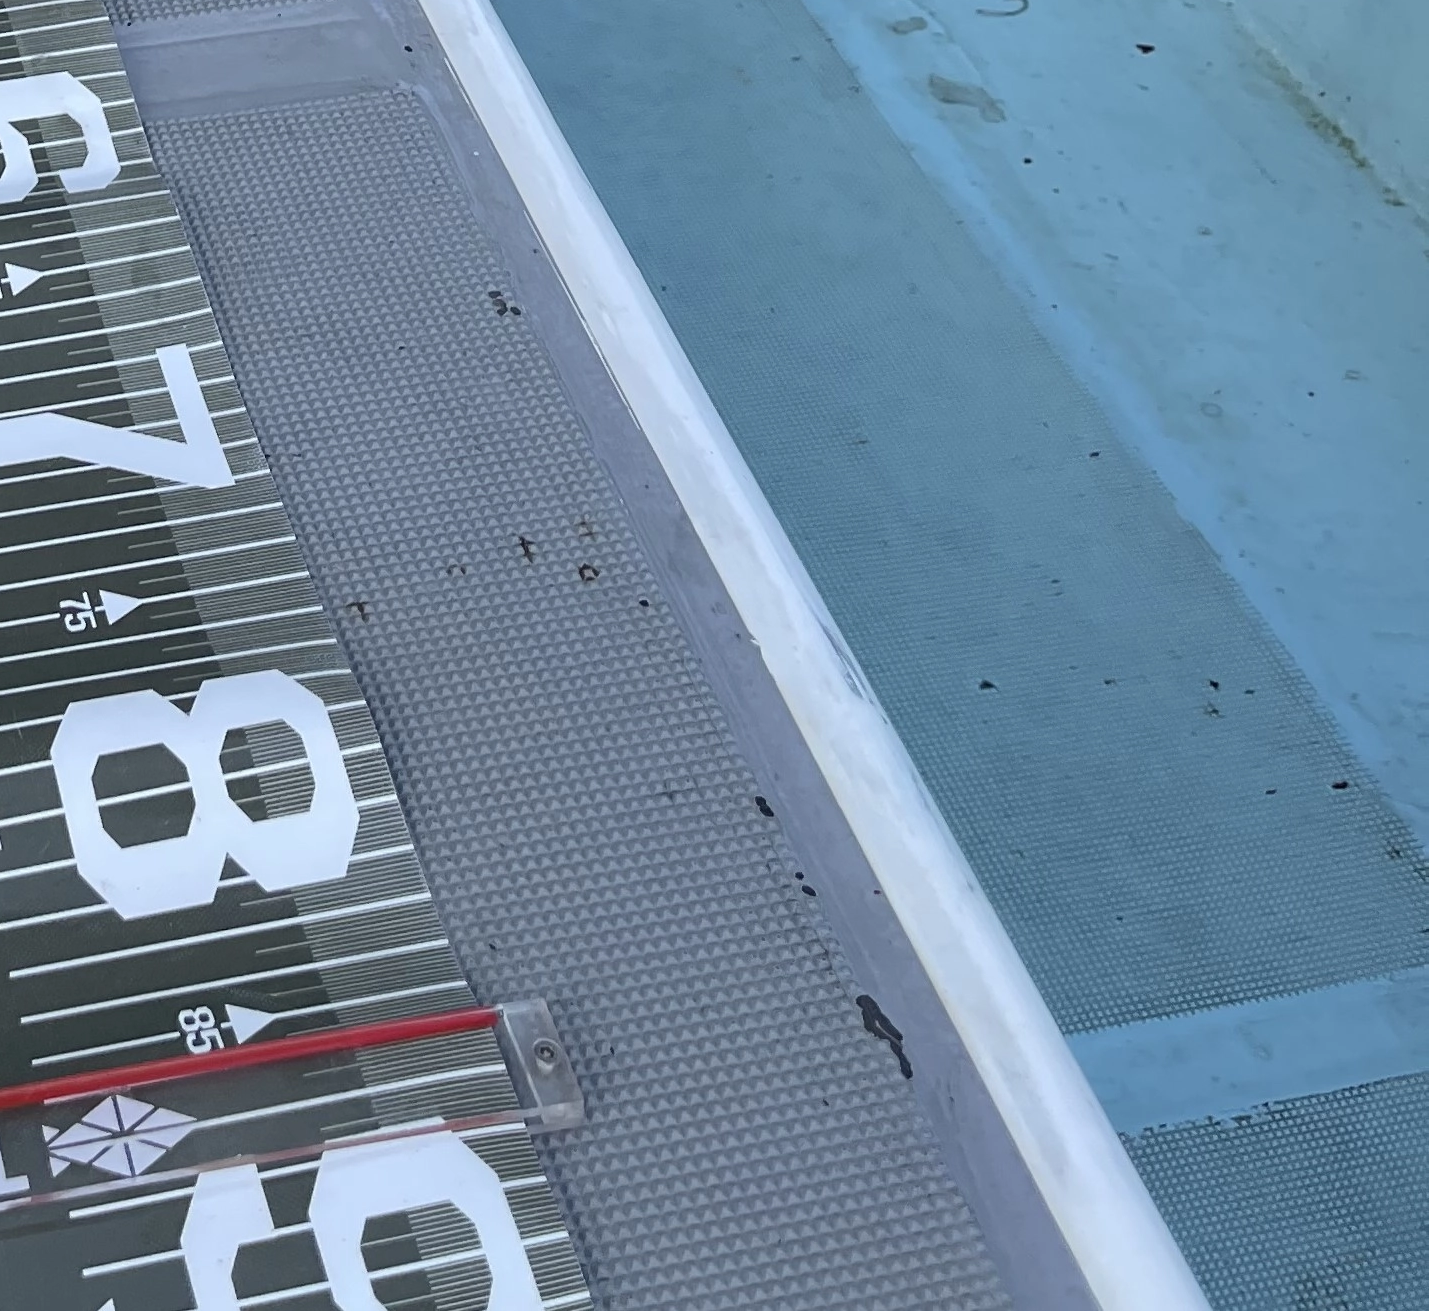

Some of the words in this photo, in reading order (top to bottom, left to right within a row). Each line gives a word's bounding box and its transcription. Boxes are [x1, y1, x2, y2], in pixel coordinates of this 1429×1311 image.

[59, 591, 97, 632] 75
[51, 669, 360, 921] 8
[178, 1006, 224, 1054] 85
